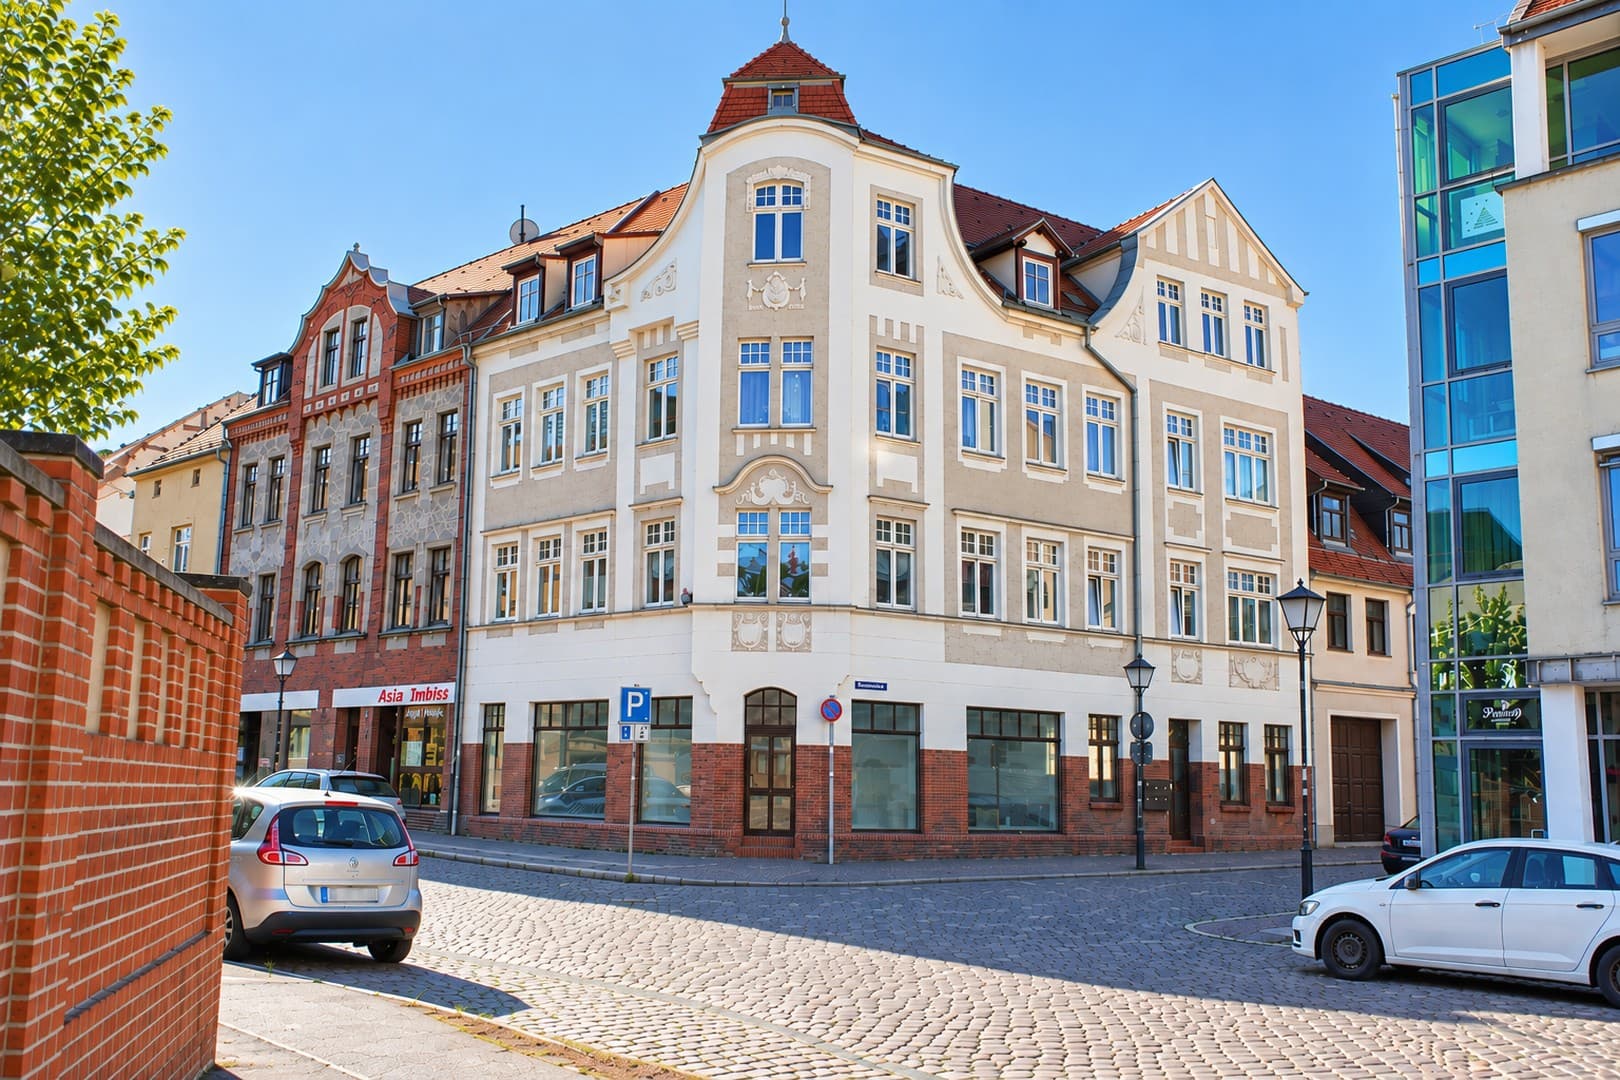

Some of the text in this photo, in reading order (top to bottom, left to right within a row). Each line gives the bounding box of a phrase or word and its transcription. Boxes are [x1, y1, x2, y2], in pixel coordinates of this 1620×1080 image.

[378, 686, 449, 703] Asia Imbiss
[627, 691, 644, 717] P
